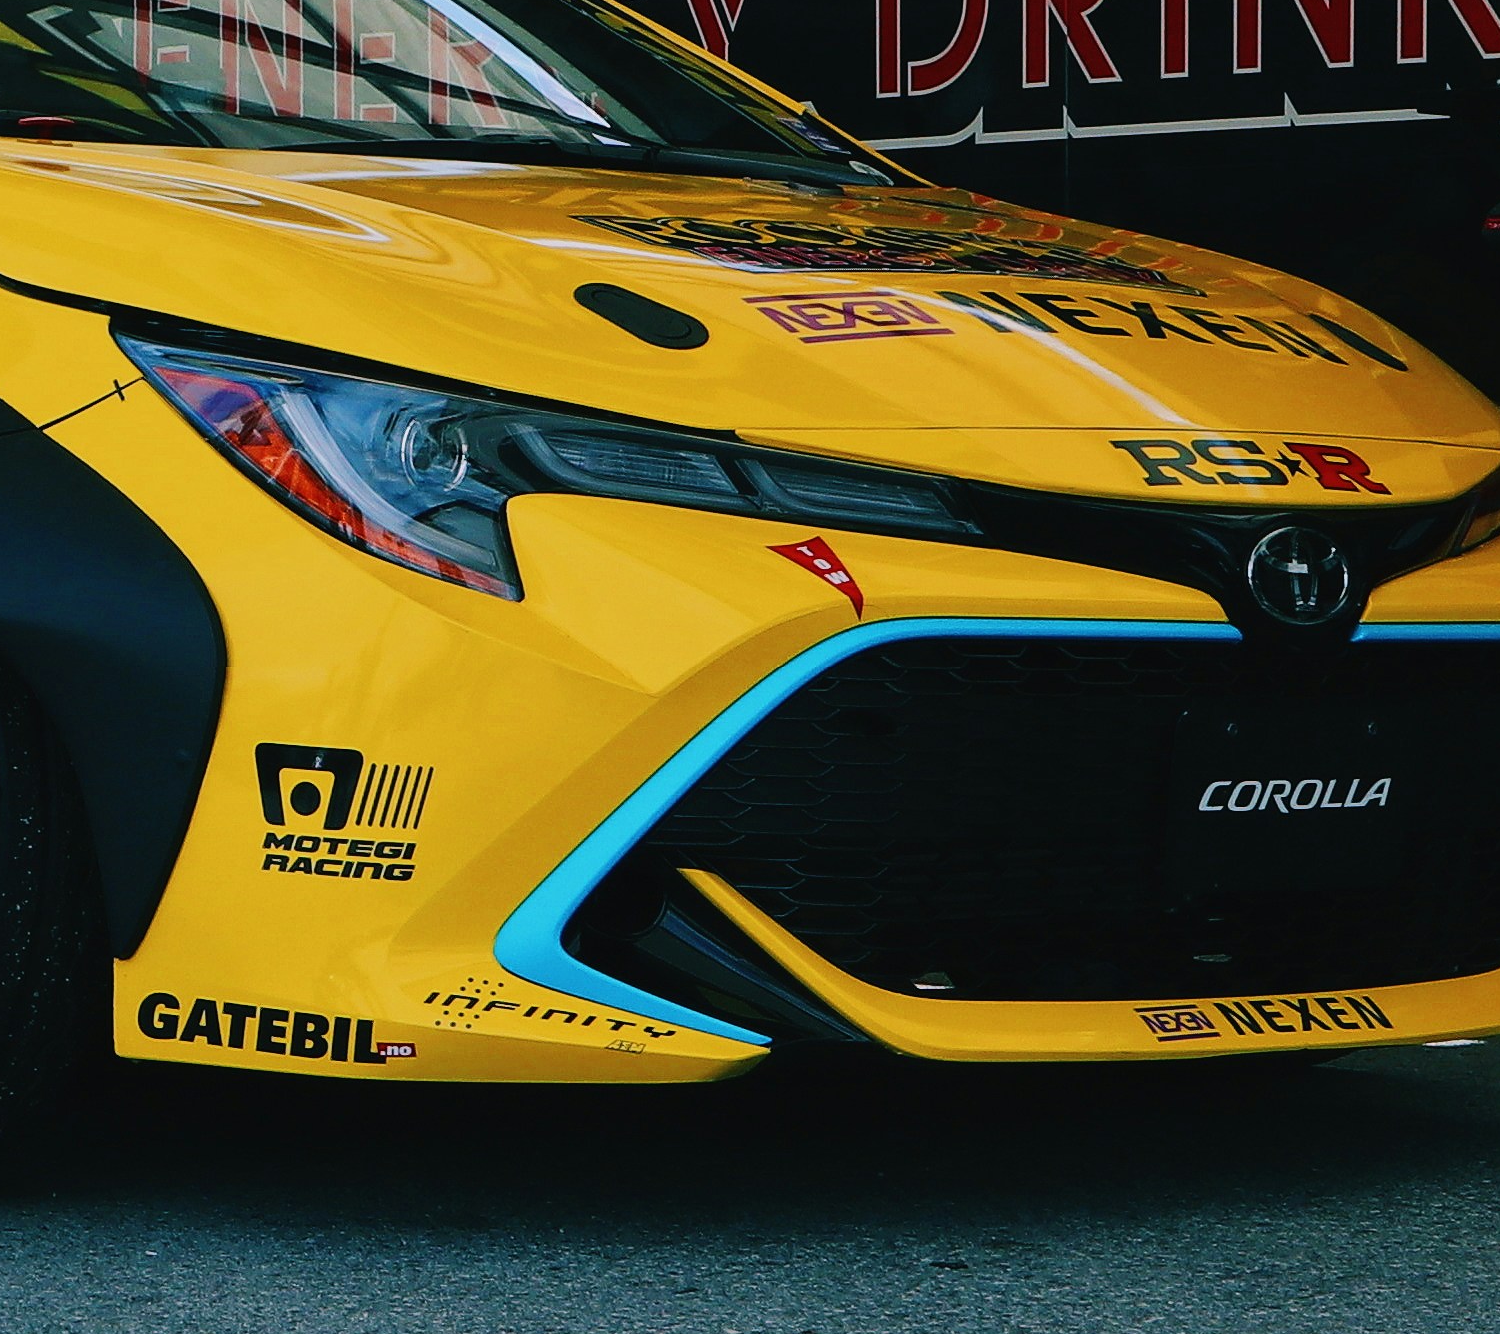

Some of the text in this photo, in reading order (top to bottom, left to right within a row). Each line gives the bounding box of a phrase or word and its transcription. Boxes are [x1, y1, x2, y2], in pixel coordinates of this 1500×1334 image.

[940, 289, 1410, 372] NEXEN
[797, 544, 852, 587] TOW
[1198, 776, 1392, 814] COROLLA
[261, 832, 417, 862] MOTEGI
[261, 853, 416, 882] RACING
[136, 992, 389, 1065] GATEBIL
[423, 991, 677, 1039] INFINITY
[1212, 995, 1395, 1036] NEXEN
